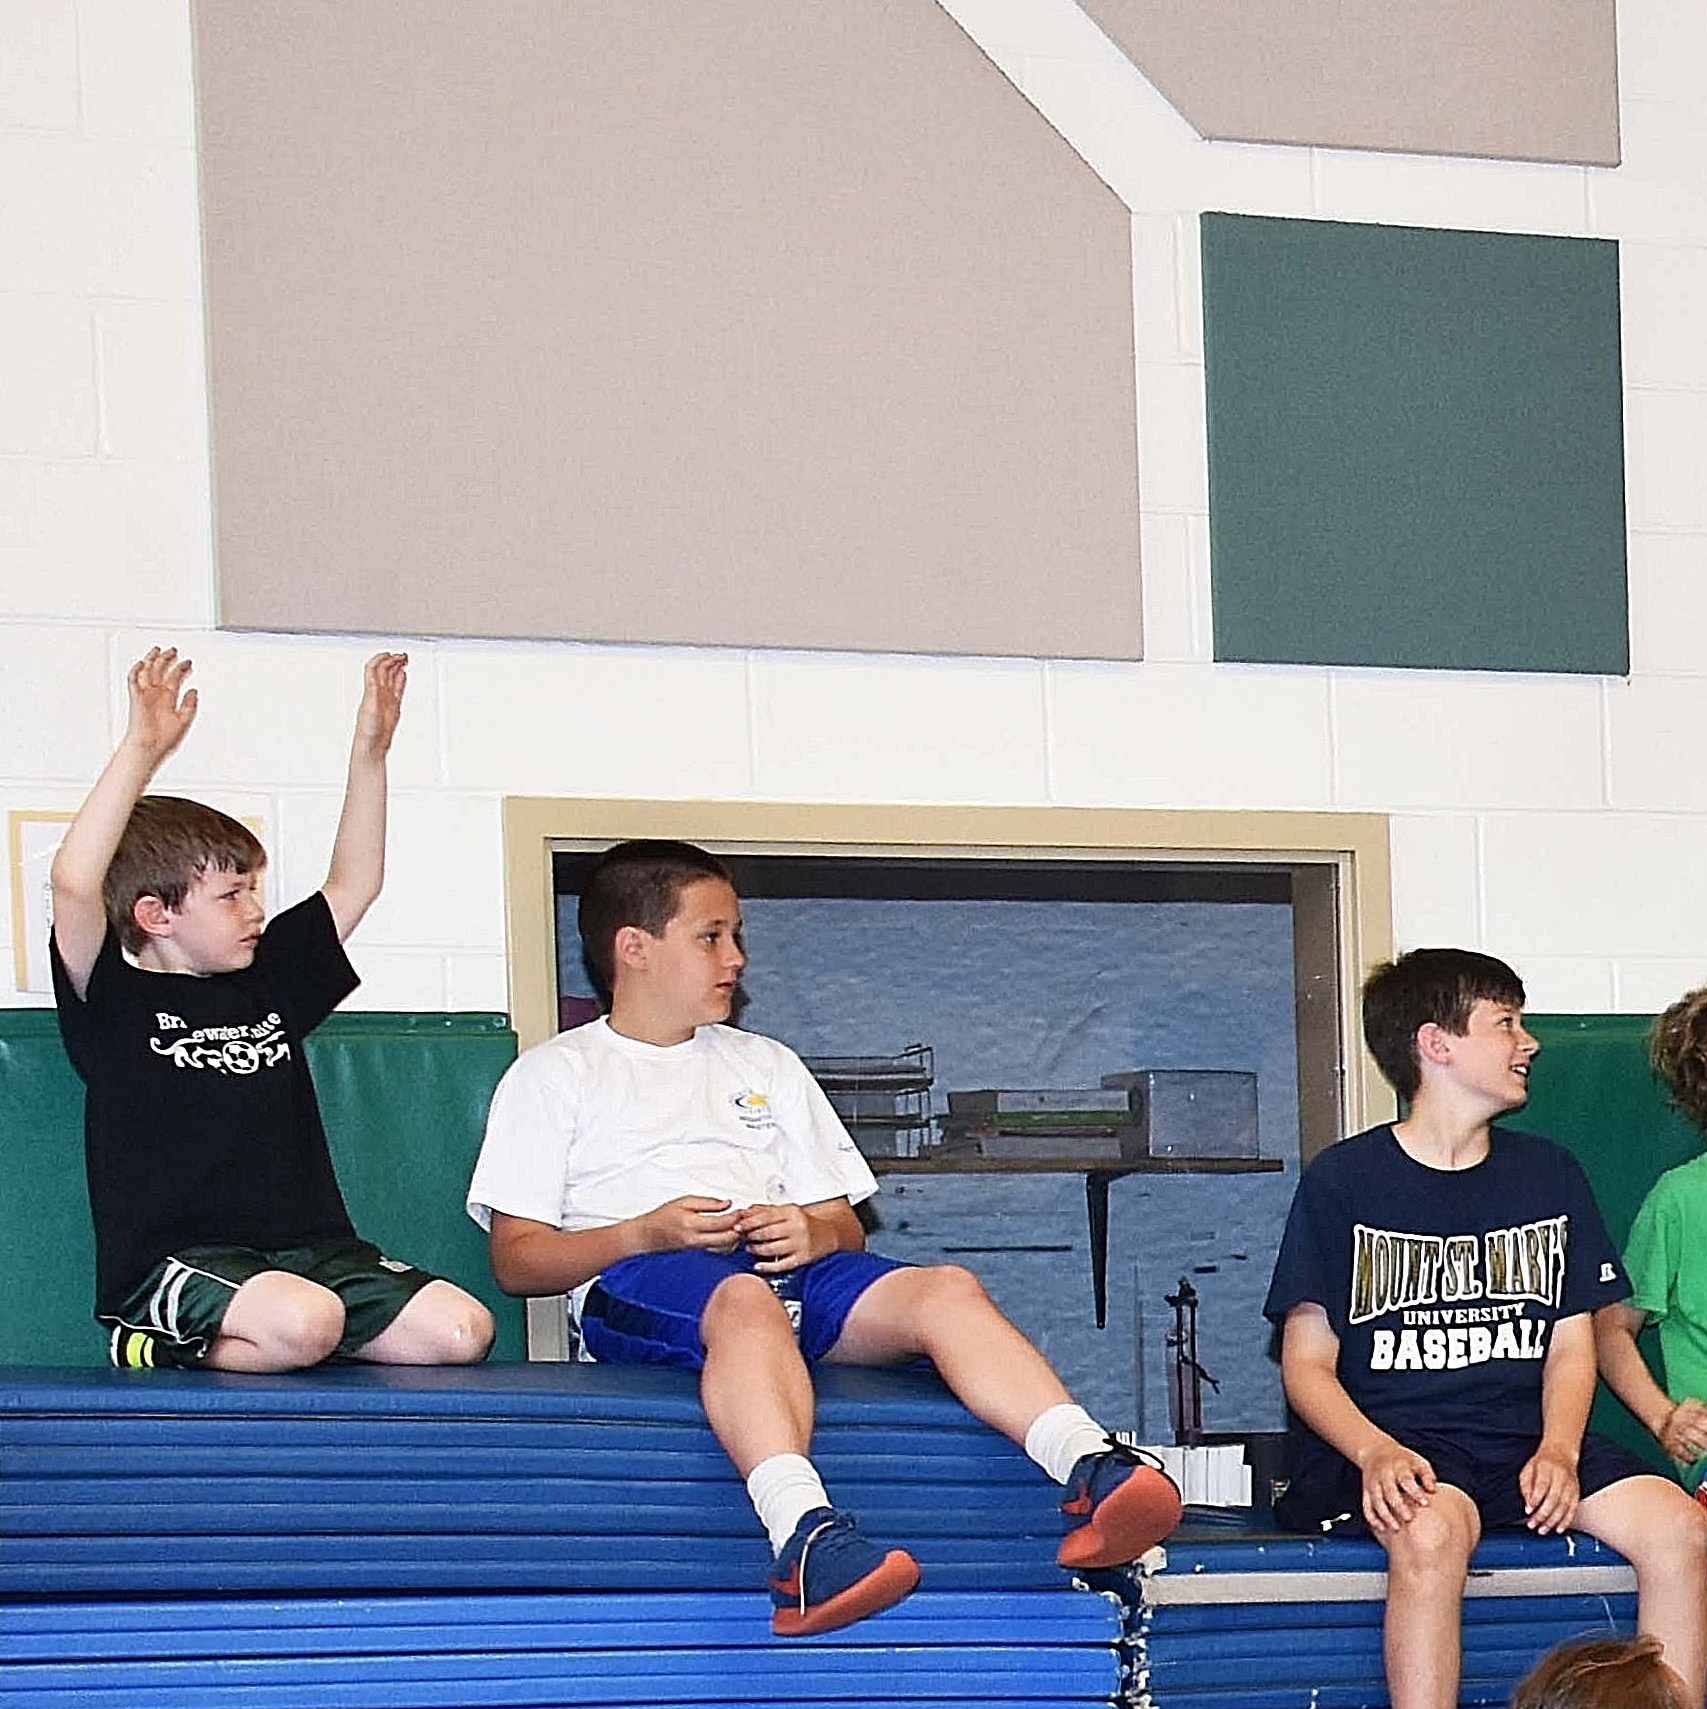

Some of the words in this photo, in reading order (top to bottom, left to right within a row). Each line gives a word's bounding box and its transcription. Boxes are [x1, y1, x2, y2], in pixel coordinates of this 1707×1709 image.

[1350, 1224, 1443, 1324] MOUNT
[1442, 1235, 1483, 1301] ST.
[1403, 1302, 1525, 1326] UNIVERSITY
[1370, 1318, 1546, 1370] BASEBALL
